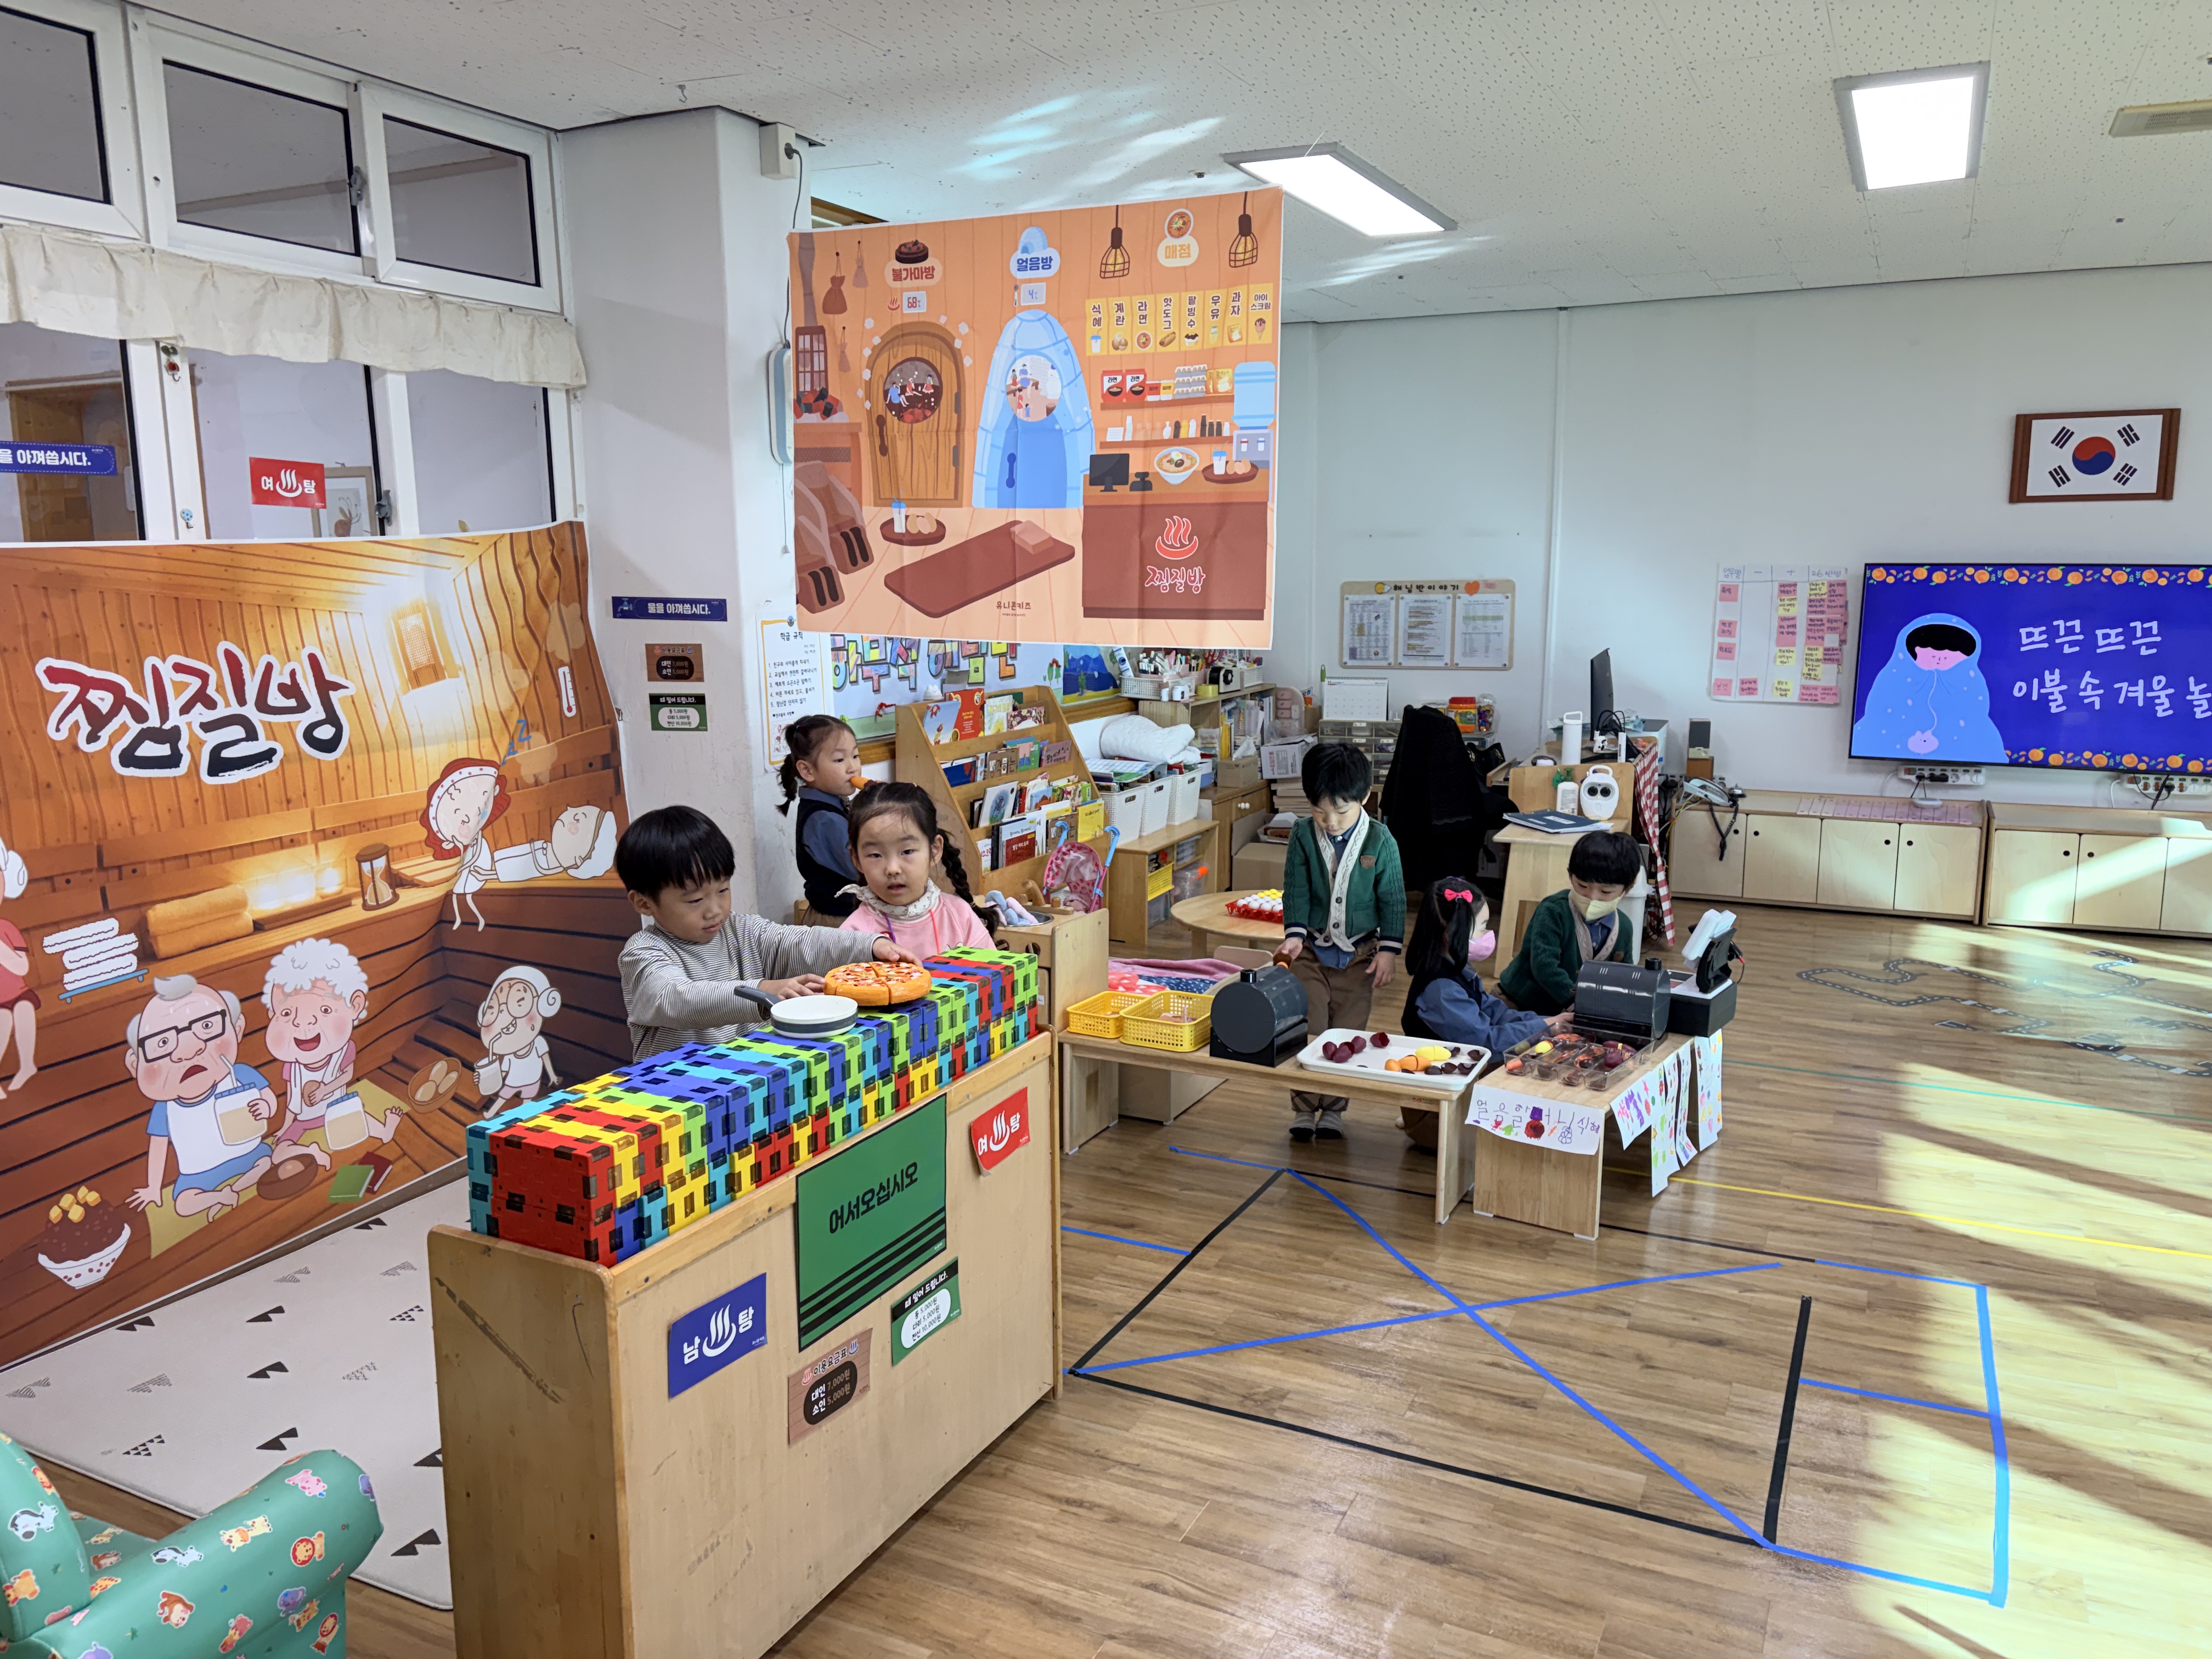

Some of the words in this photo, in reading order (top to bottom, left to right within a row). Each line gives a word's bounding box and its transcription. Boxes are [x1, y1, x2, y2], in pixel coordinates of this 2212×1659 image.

[1017, 255, 1053, 272] 얼음방
[1164, 244, 1191, 259] 매점
[891, 266, 935, 282] 불가마방
[1210, 295, 1221, 320] 우유
[1229, 291, 1242, 317] 과자
[1250, 302, 1271, 311] 스크림
[1254, 293, 1268, 301] 아이
[1091, 303, 1103, 328] 식혜
[1114, 302, 1125, 326] 계란
[1137, 301, 1148, 325] 라면
[1163, 296, 1172, 330] 핫도그
[1187, 295, 1197, 329] 팥빙수
[16, 449, 92, 466] 아껴씁시다.
[261, 476, 274, 491] 여
[303, 479, 316, 494] 탕
[1144, 566, 1206, 594] 찜질방
[1393, 584, 1425, 594] 해님반
[647, 602, 664, 614] 물을
[667, 603, 711, 615] 아껴씁시다.
[996, 601, 1031, 611] 유니콘키즈
[780, 632, 791, 641] 학급
[793, 631, 803, 640] 규칙
[2019, 619, 2084, 654] 뜨끈
[2096, 620, 2162, 656] 뜨끈
[2012, 668, 2067, 714] 이불
[2078, 670, 2104, 710] 속
[2114, 674, 2175, 718] 겨울
[40, 644, 353, 780] 찜질방
[978, 1134, 988, 1156] 여
[1010, 1112, 1021, 1133] 탕
[829, 1161, 918, 1234] 어서오십시오
[905, 1296, 911, 1309] 때
[912, 1287, 924, 1304] 밀어
[925, 1270, 948, 1294] 드립니다.
[683, 1335, 701, 1365] 남
[738, 1306, 754, 1334] 탕
[912, 1319, 922, 1330] 다리
[912, 1330, 921, 1341] 전신
[813, 1347, 848, 1375] 이용요금표
[811, 1384, 826, 1402] 대인
[827, 1368, 850, 1391] 7,000원
[812, 1398, 826, 1416] 소인
[827, 1383, 850, 1406] 5,000원
